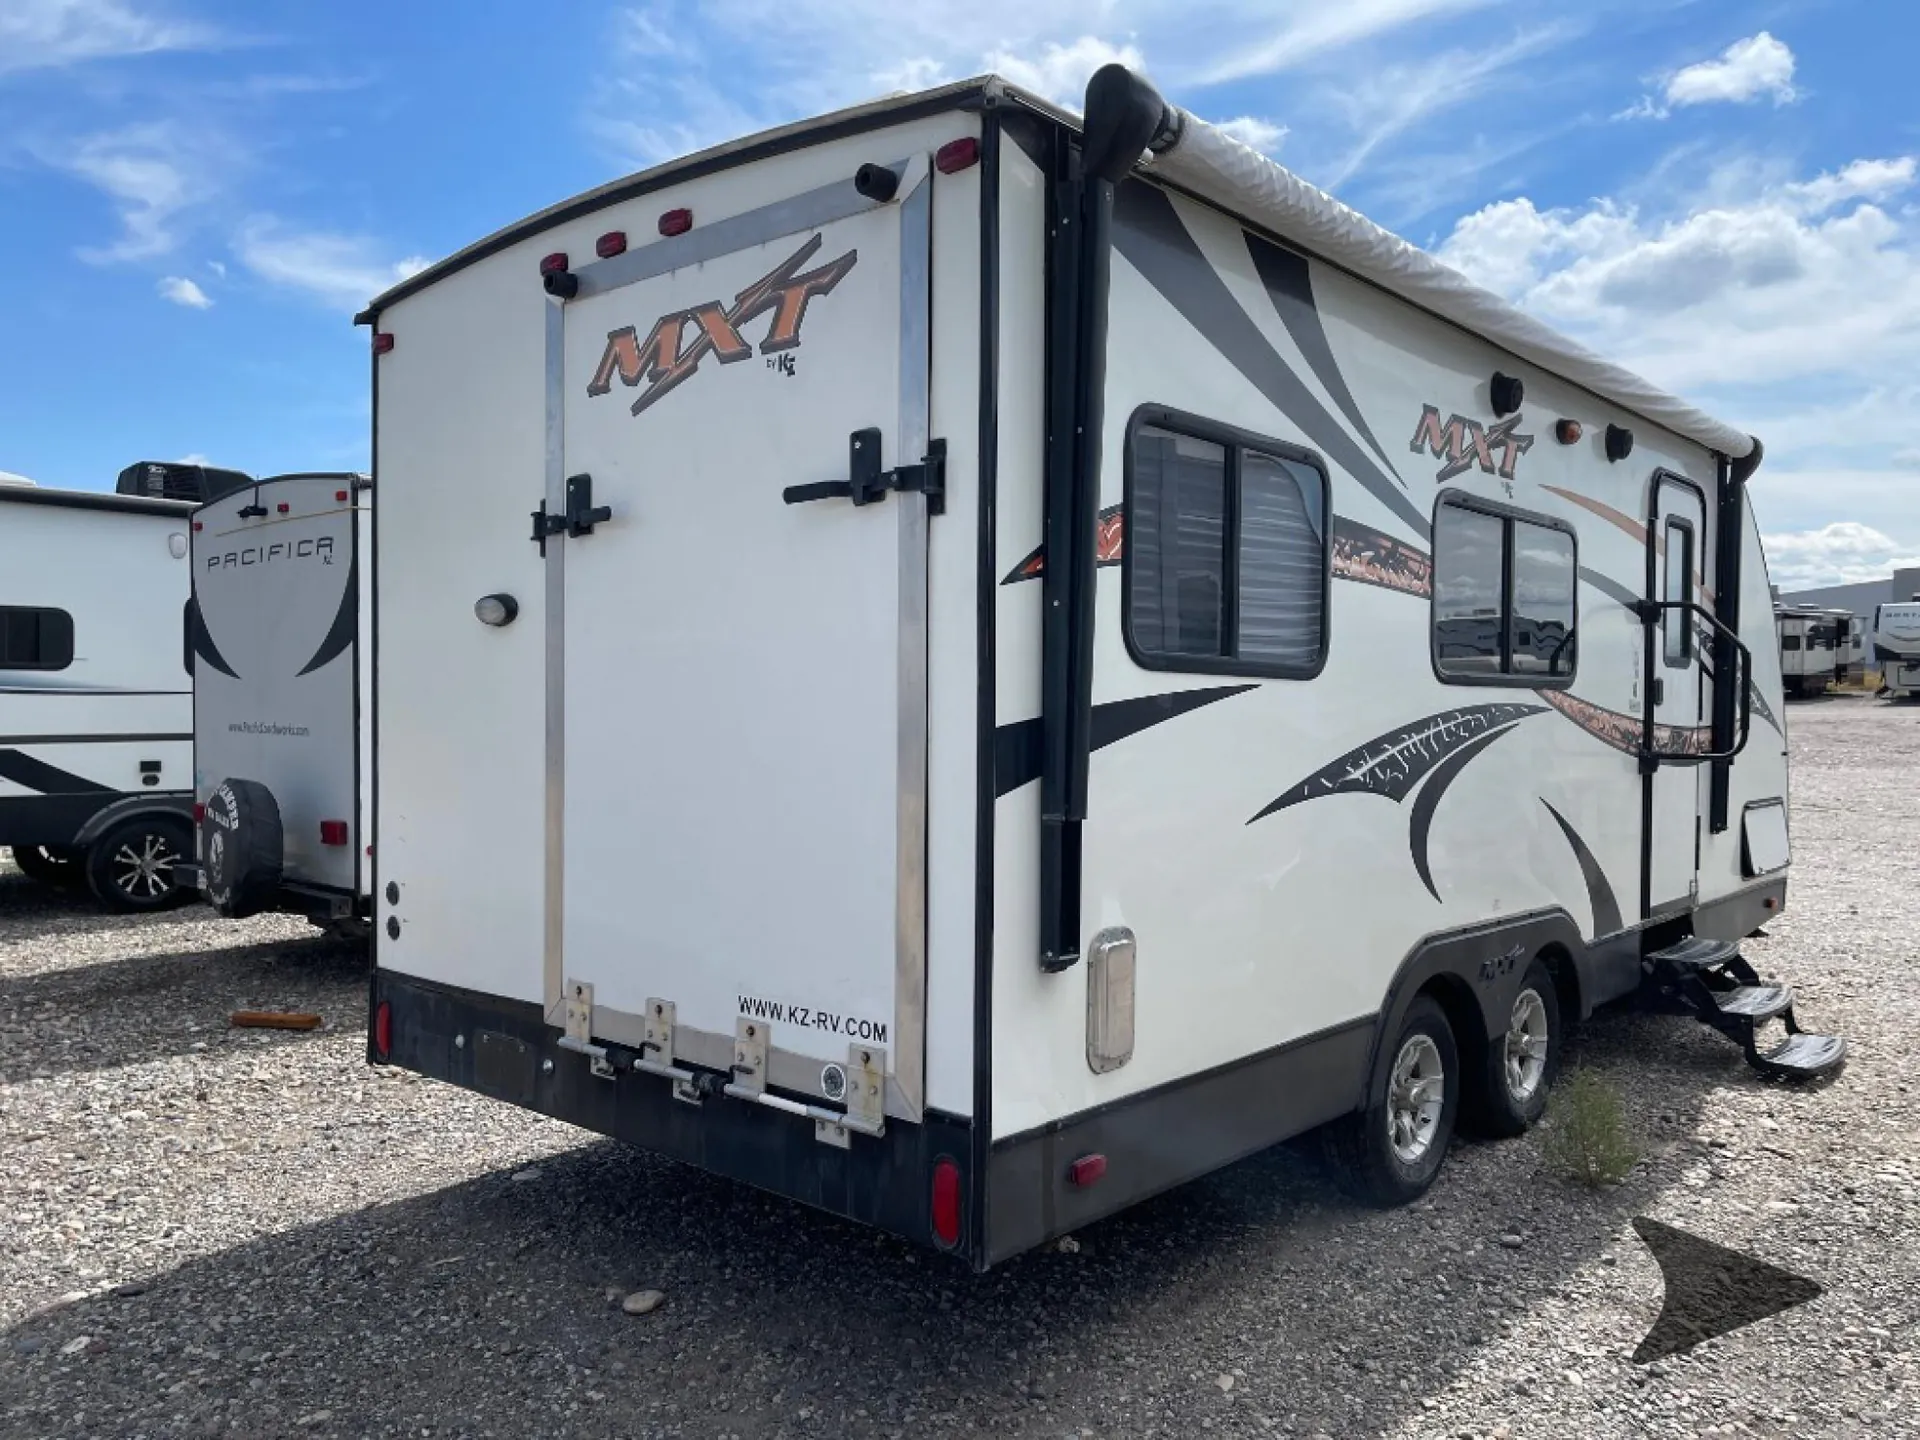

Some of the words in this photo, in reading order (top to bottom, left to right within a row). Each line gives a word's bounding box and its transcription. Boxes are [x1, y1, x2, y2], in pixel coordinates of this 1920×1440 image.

[587, 232, 857, 417] MXT
[1410, 403, 1535, 484] MXT
[207, 536, 334, 573] PACIFICA
[738, 995, 888, 1043] WWW.KZ-RV.COM
